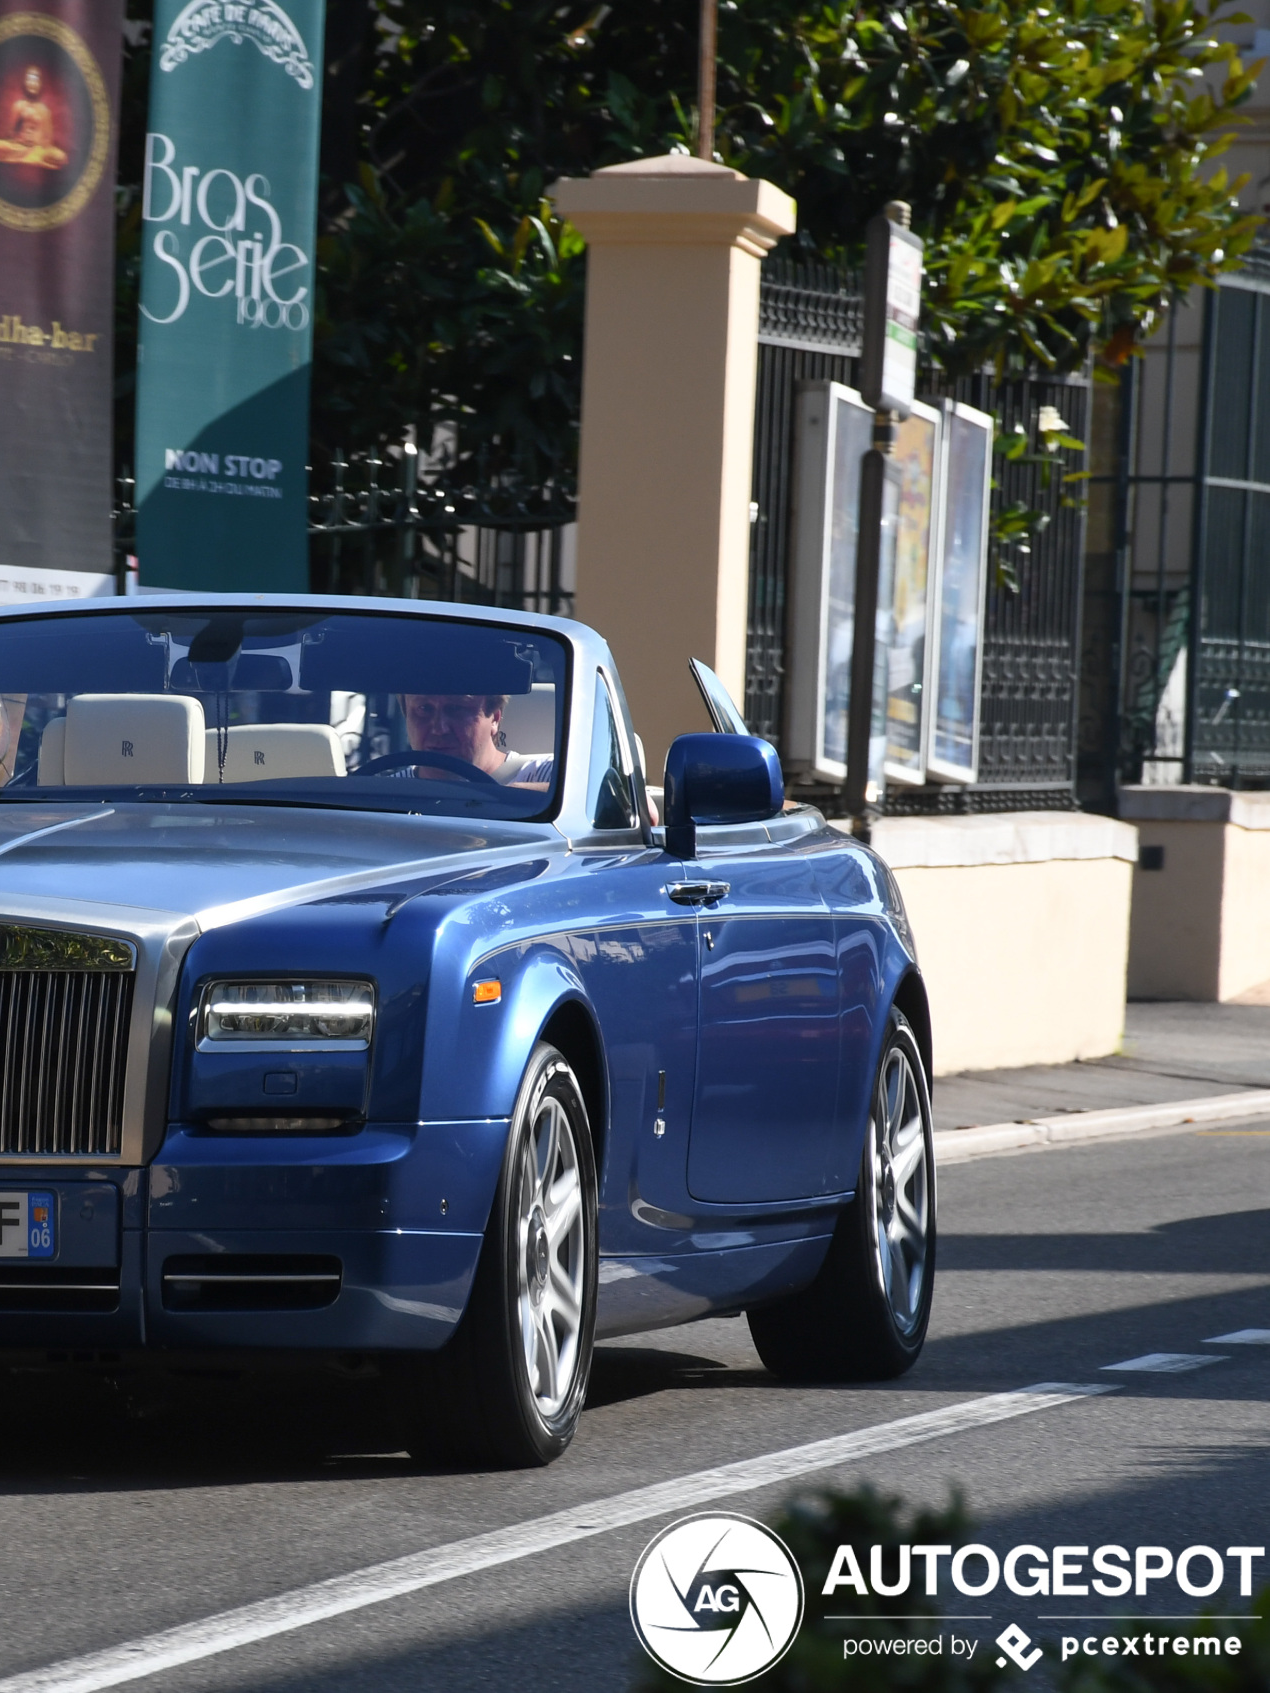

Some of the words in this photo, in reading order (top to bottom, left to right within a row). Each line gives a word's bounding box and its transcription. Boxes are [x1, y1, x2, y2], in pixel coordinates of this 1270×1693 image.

[236, 296, 309, 331] 1900
[164, 448, 219, 475] NON
[224, 454, 283, 481] STOP
[31, 1228, 51, 1248] 06
